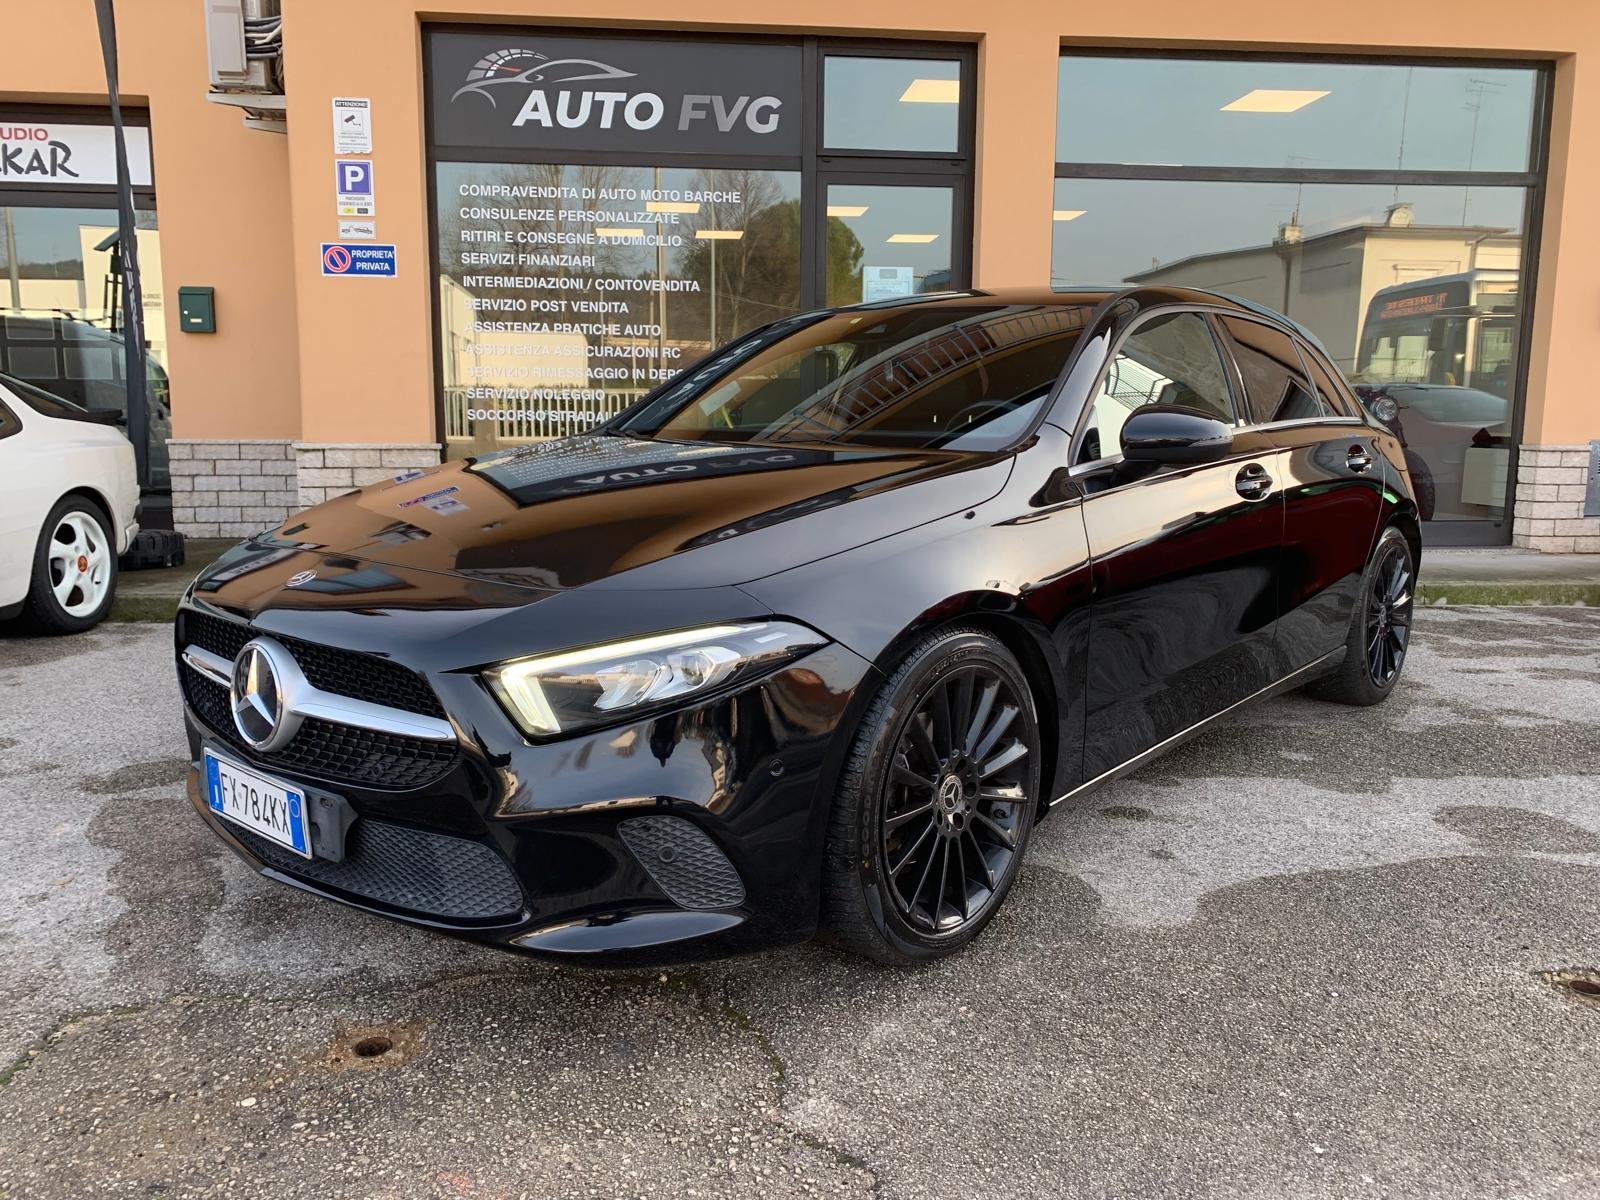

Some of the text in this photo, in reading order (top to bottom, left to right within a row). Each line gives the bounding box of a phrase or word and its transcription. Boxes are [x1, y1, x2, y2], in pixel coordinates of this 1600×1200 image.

[511, 89, 783, 134] AUTO FVG
[0, 140, 80, 178] KAR
[344, 165, 365, 191] P
[459, 184, 741, 204] COMPRAVENDITA DI AUTO MOTO BARCHE
[459, 207, 680, 225] CONSULENZE PERSONALIZZATE
[461, 230, 682, 247] RITIRI E CONSEGNE A DOMICILIO
[356, 261, 391, 271] PRIVATA
[461, 252, 596, 267] SERVIZI FINANZIARI
[463, 275, 584, 290] INTERMEDIAZIONI
[595, 278, 701, 292] CONTOVENDITA
[463, 298, 629, 314] SERVIZIO POST VENDITA
[463, 321, 662, 336] ASSISTENZA PRATICHE AUTO
[554, 344, 659, 359] ASSICURAZIONI
[662, 347, 682, 359] RC
[632, 368, 646, 380] IN
[466, 387, 606, 401] SERVIZIO NOLEGGIO
[467, 409, 546, 422] SOCCORSO
